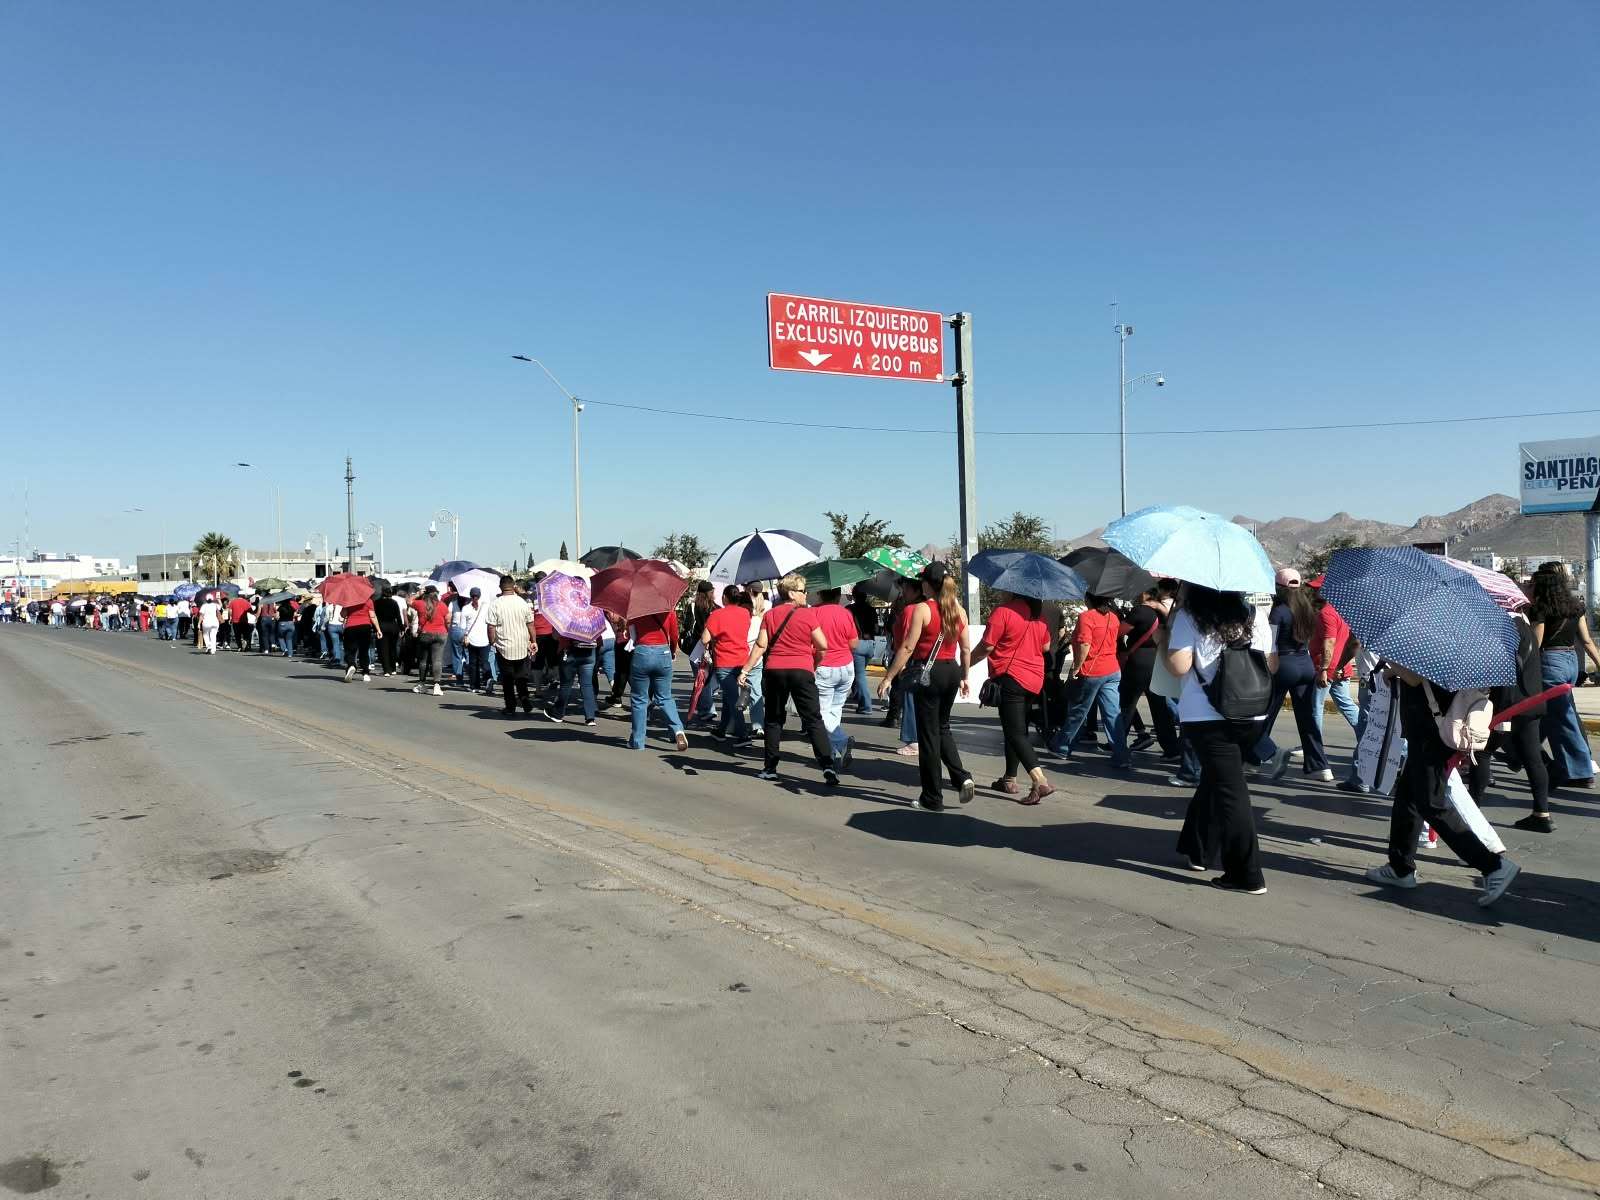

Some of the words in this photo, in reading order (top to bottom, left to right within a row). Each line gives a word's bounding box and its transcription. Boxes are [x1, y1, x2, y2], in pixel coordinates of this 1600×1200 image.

[786, 302, 844, 325] CARRIL
[850, 309, 928, 333] IZQUIERDO
[775, 322, 863, 347] EXCLUSIVO
[852, 353, 863, 369] A
[871, 354, 902, 372] 200
[909, 360, 921, 374] m
[1524, 457, 1600, 481] SANTIAG
